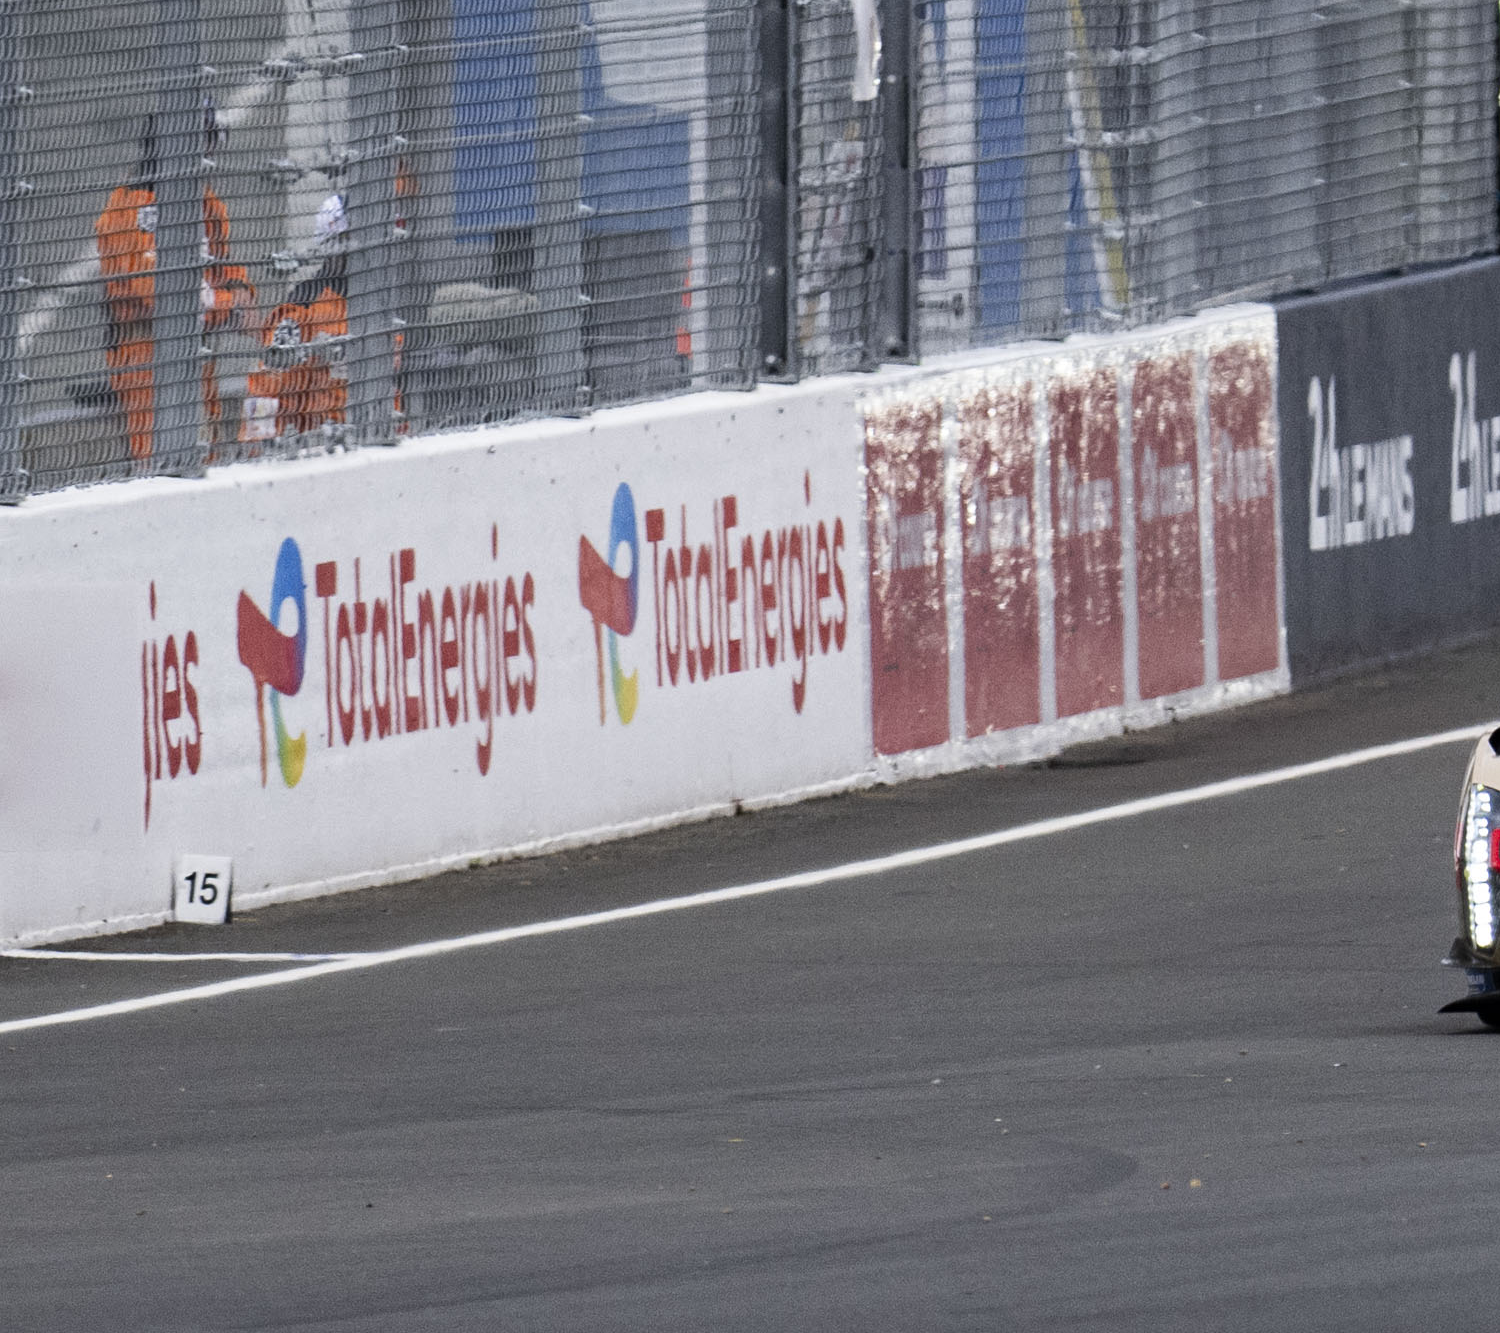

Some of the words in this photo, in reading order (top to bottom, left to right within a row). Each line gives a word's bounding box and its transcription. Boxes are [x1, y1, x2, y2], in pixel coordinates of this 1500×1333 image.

[315, 521, 538, 776] TotalEnergies
[645, 467, 848, 715] TotalEnergies
[184, 870, 219, 906] 15
